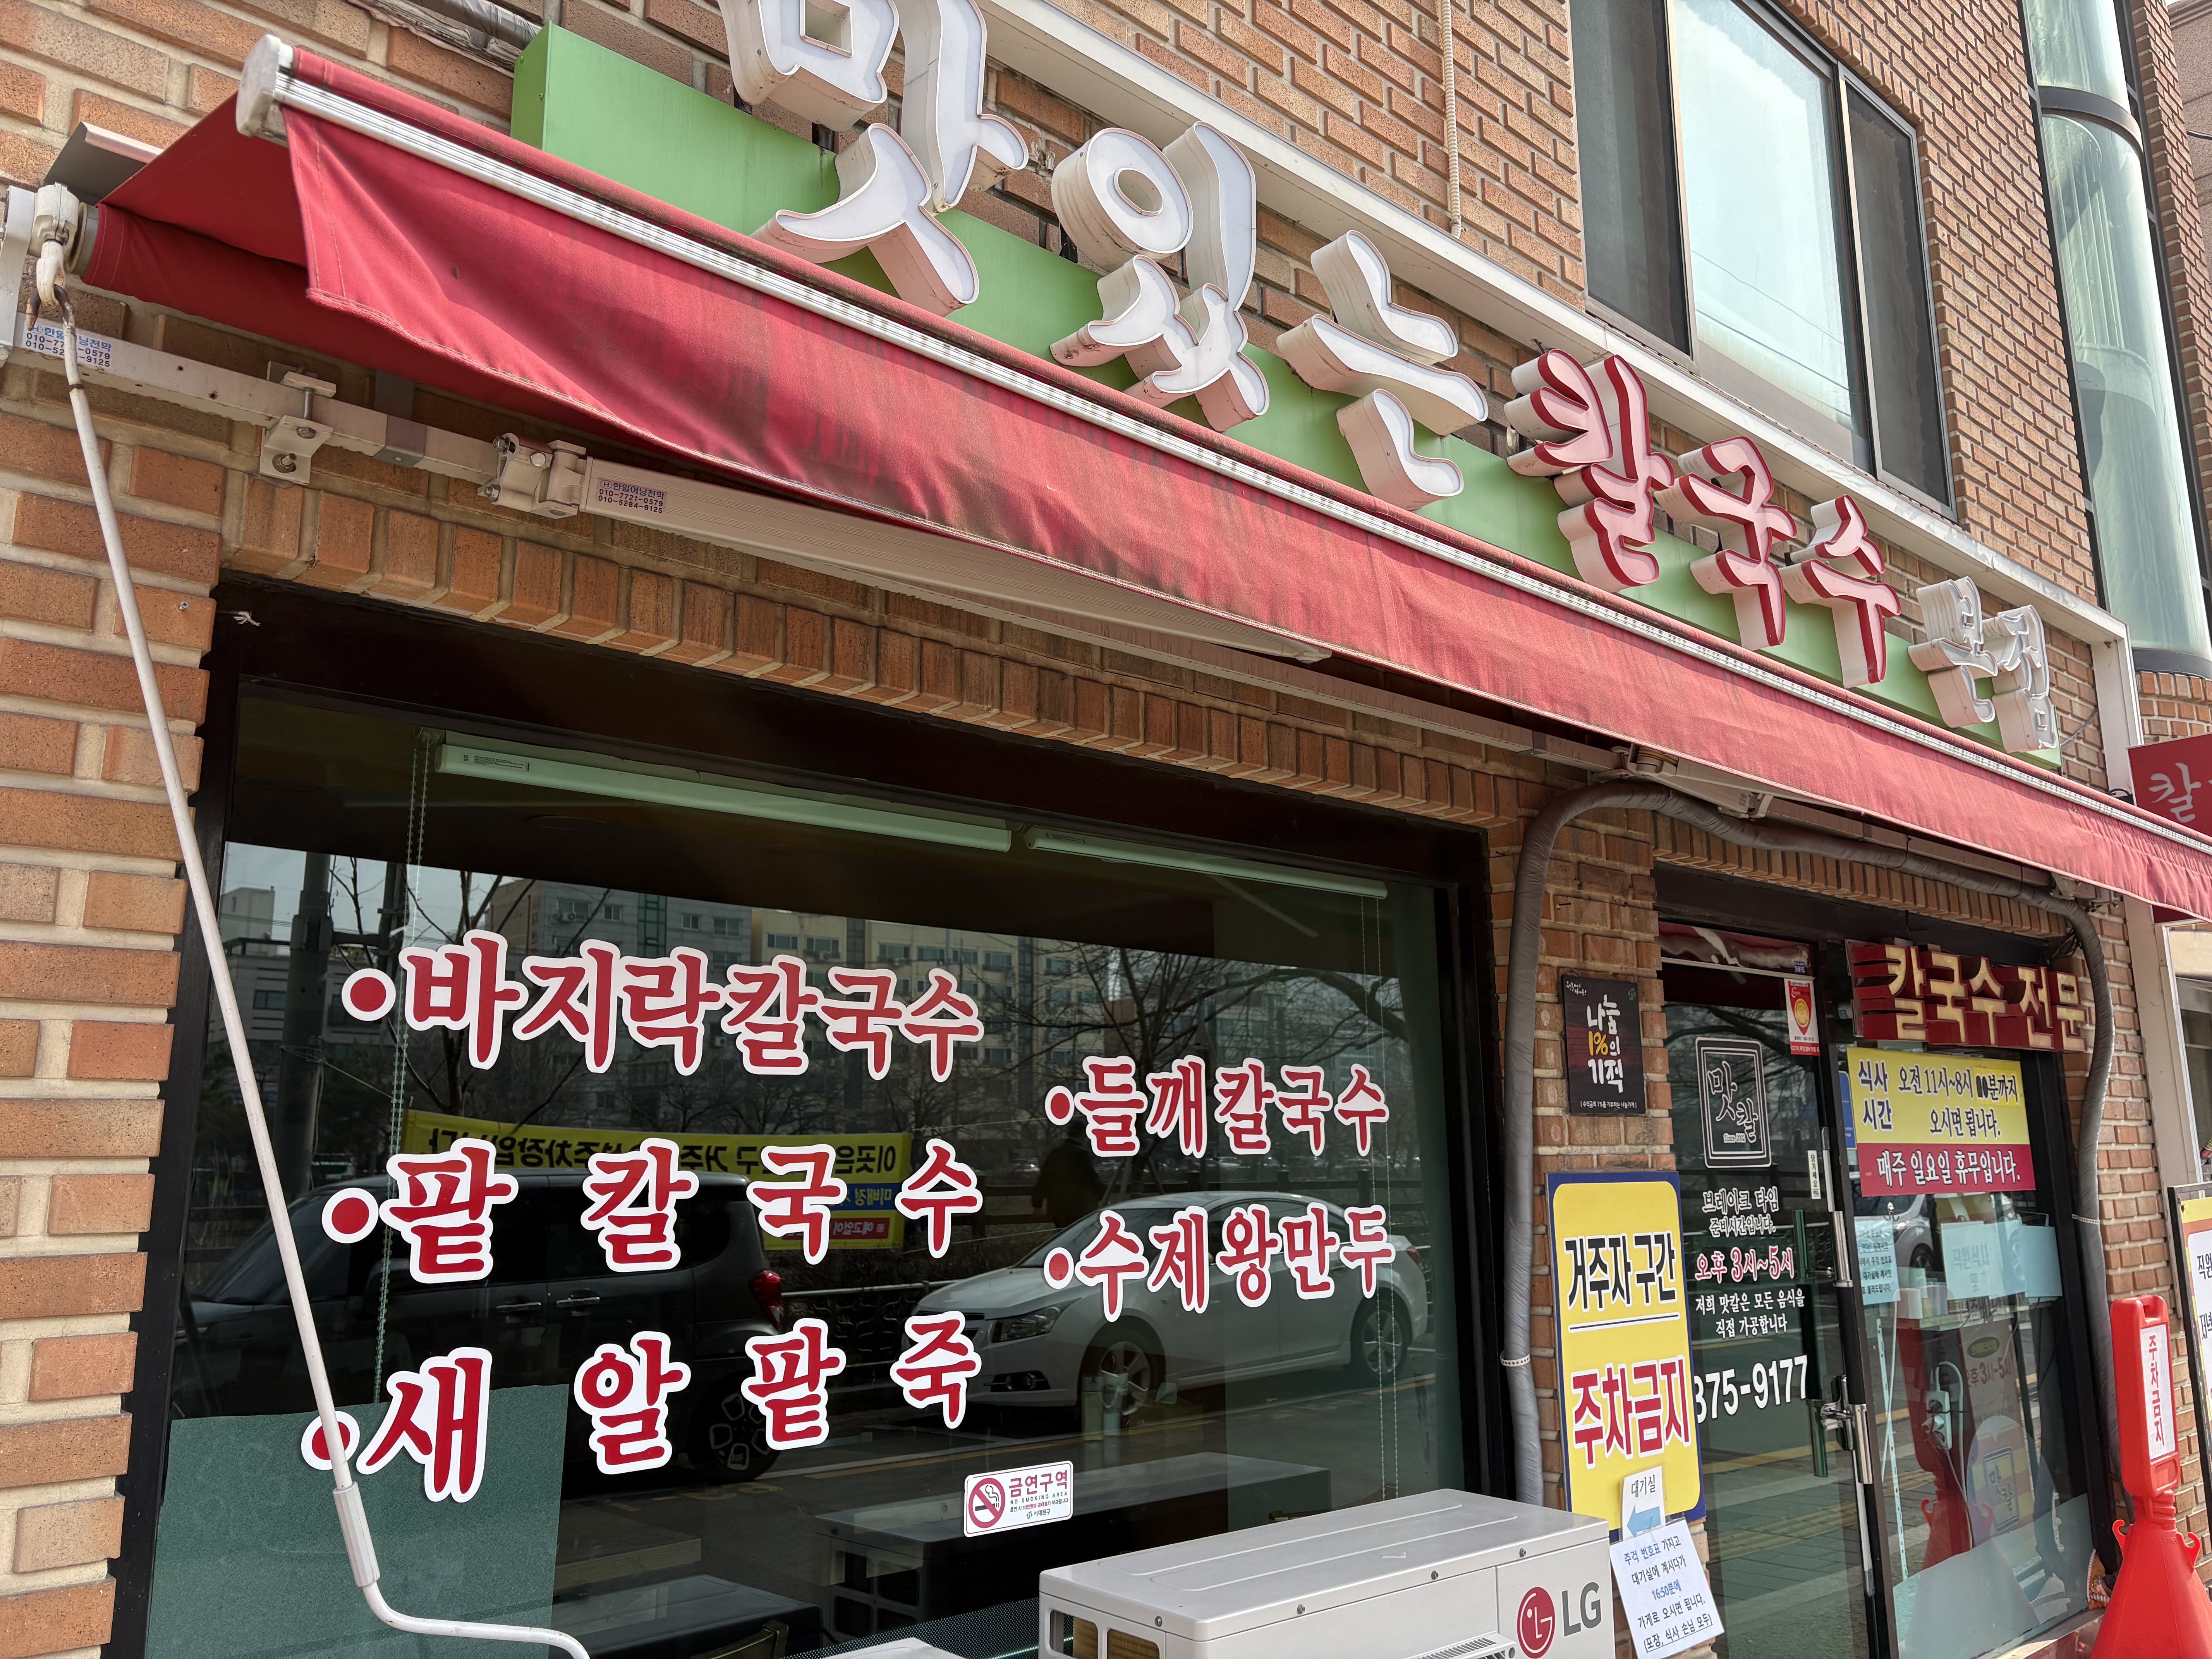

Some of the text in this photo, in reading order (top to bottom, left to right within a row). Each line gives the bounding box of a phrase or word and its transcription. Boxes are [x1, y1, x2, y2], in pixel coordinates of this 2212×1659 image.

[26, 340, 110, 367] 010-52-9125
[27, 333, 110, 359] 010-77-0579
[44, 327, 112, 352] 한일닝천막
[722, 0, 2056, 753] 맛있는 칼국수 본점
[598, 495, 663, 513] 010-5284-9125
[599, 489, 663, 507] 010-7721-0579
[613, 483, 665, 500] 한일어닝천막
[2148, 762, 2212, 823] 칼
[401, 931, 983, 1081] 바지락칼국수
[1859, 944, 2090, 1051] 칼국수 전문
[1587, 994, 1620, 1035] 나눔
[1588, 1031, 1620, 1056] 1%의
[1588, 1058, 1623, 1093] 기적
[1858, 1060, 1888, 1093] 식사
[1898, 1065, 1923, 1095] 오전
[1924, 1067, 1973, 1099] 11시~8시
[1075, 1056, 1389, 1157] 들깨칼국수
[1863, 1099, 1893, 1130] 시간
[1930, 1107, 2001, 1138] 오시면 됩니다.
[1877, 1149, 2021, 1187] 매주 일요일 휴무입니다.
[1702, 1186, 1779, 1215] 브레이크 타임
[1709, 1213, 1776, 1237] 준비시간입니다.
[1075, 1204, 1395, 1321] 수제왕만두
[1564, 1231, 1677, 1312] 거주자 구간
[1695, 1245, 1794, 1283] 오후 3시~5시
[1695, 1288, 1805, 1316] 저희 맛칼은 모든 음식을
[1716, 1313, 1788, 1339] 직접 가공합니다
[2149, 1335, 2164, 1446] 주차금지
[1571, 1356, 1691, 1469] 주차금지
[1009, 1470, 1067, 1498] 금연구역
[1022, 1494, 1049, 1503] SMOKING
[1631, 1474, 1656, 1498] 대기실
[1034, 1509, 1051, 1517] 서대문구
[1624, 1536, 1681, 1566] 주걱 번호표 가지고
[1632, 1564, 1660, 1585] 대기실에
[1652, 1579, 1681, 1600] 16:50분에
[1562, 1582, 1601, 1637] LG
[1638, 1592, 1705, 1629] 가게로 오시면 됩니다.
[1666, 1626, 1680, 1641] 식사
[1682, 1619, 1695, 1635] 손님
[1697, 1613, 1713, 1628] 모두)
